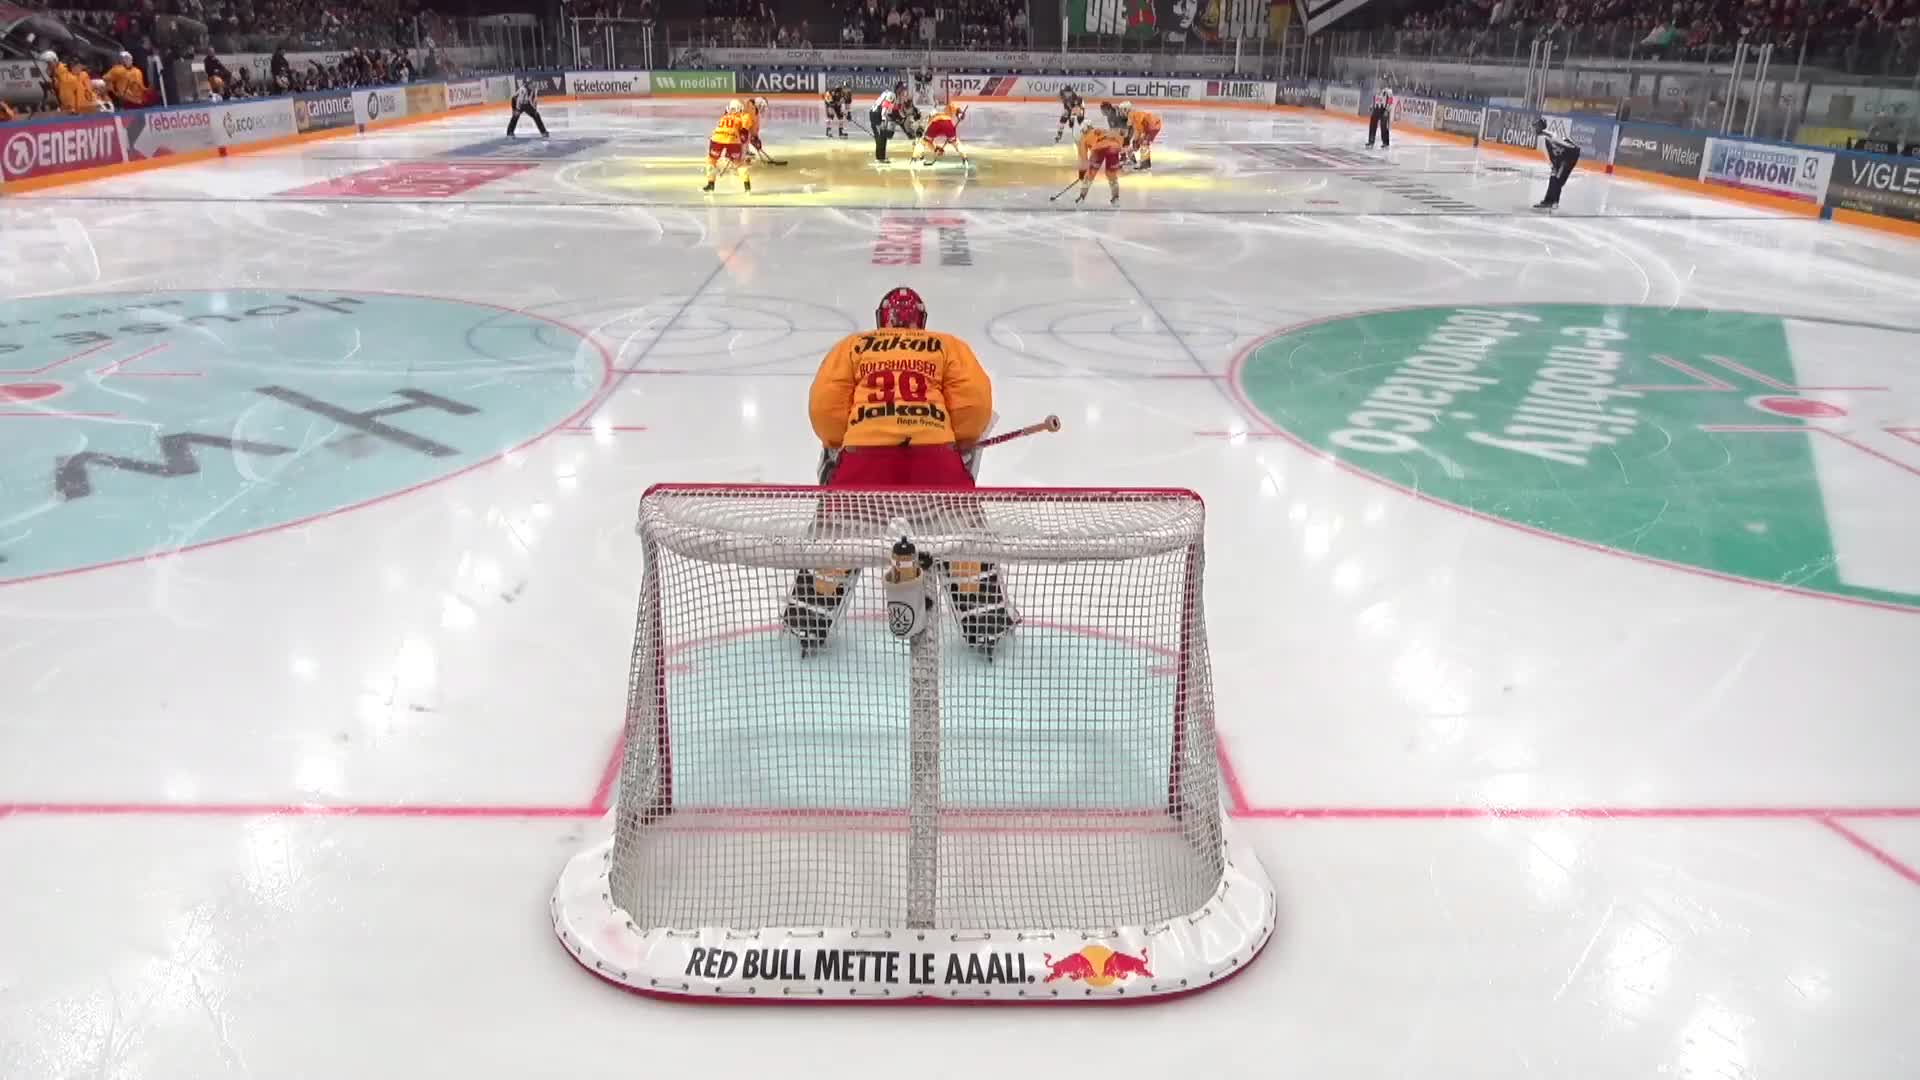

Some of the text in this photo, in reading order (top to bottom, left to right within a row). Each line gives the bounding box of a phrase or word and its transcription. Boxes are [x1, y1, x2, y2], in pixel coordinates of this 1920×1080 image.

[573, 79, 632, 93] ticketcorner
[38, 125, 114, 166] ENERVIT
[1502, 127, 1536, 147] LONGHI
[1661, 143, 1700, 166] Winteler
[1726, 156, 1797, 185] FORNONI
[859, 359, 937, 378] BOLTSHAUSER
[685, 947, 1035, 984] RED BULL METTE LE AAALI.
